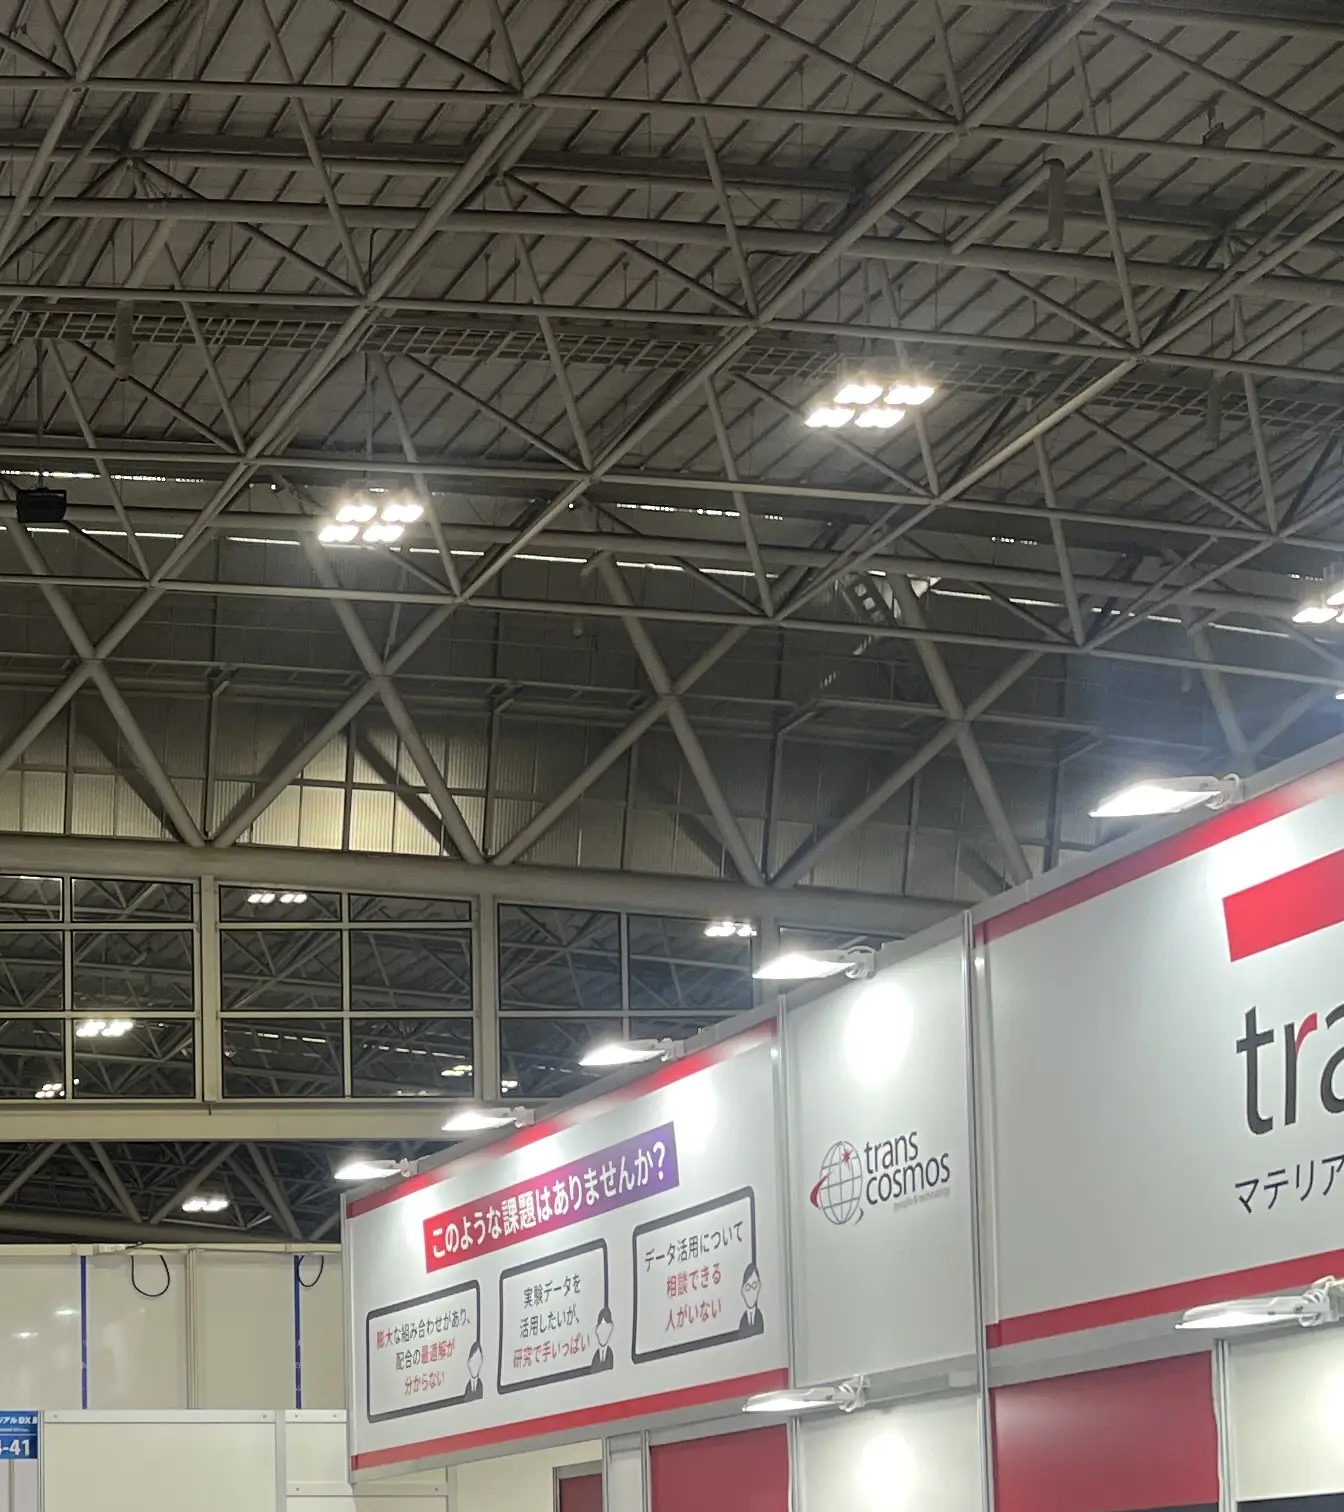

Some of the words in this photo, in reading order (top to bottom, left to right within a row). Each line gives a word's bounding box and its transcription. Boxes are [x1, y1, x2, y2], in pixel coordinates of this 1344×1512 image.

[864, 1131, 918, 1174] trans
[866, 1153, 950, 1205] cosmos
[1235, 1155, 1344, 1213] マテリア
[432, 1141, 666, 1259] このような課題はありませんか?
[645, 1221, 743, 1272] データ活用について
[523, 1274, 581, 1309] 実験データを
[666, 1263, 722, 1298] 相談できる
[520, 1304, 580, 1338] 活用したいが、
[665, 1299, 722, 1332] 人がいない
[513, 1333, 591, 1368] 研究で手いっぱい
